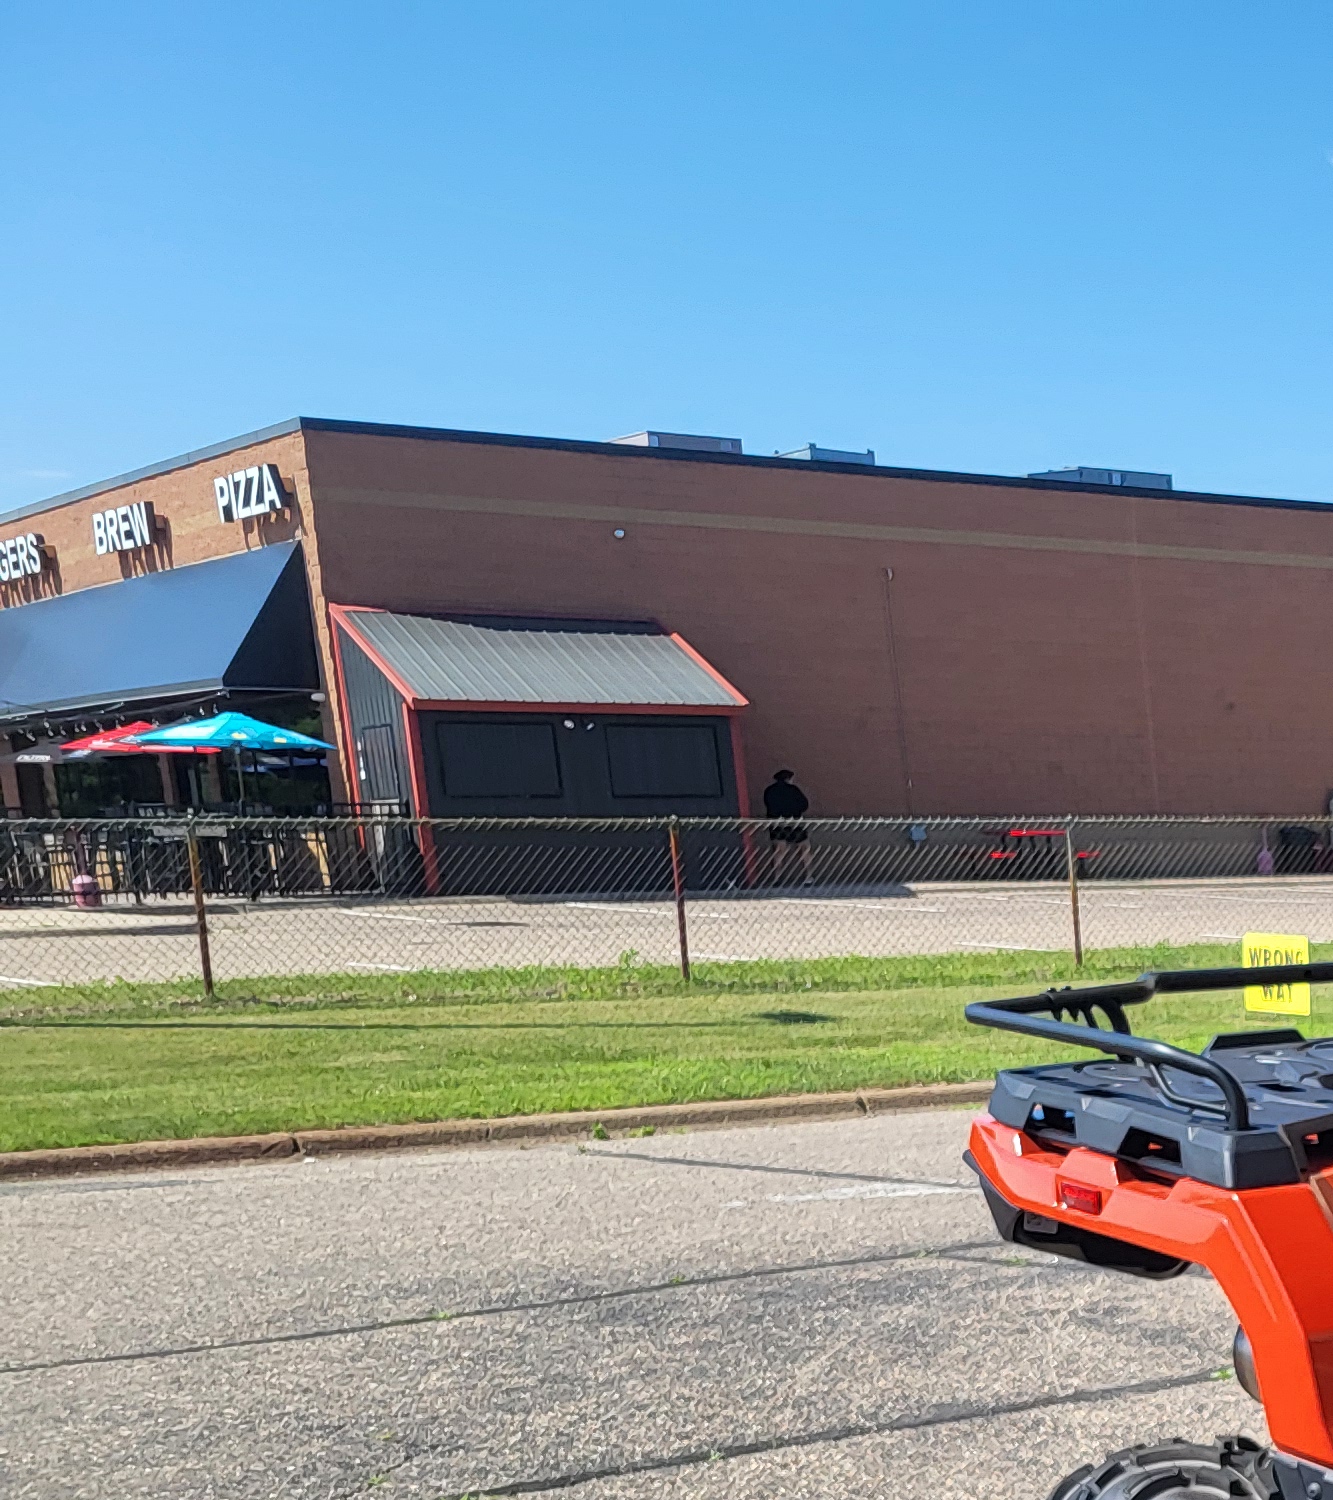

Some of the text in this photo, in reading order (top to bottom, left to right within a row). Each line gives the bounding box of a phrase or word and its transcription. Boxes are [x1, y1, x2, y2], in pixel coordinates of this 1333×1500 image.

[214, 463, 281, 523] PIZZA
[93, 501, 150, 555] BREW
[0, 533, 40, 581] GERS
[1249, 947, 1303, 968] WRONG
